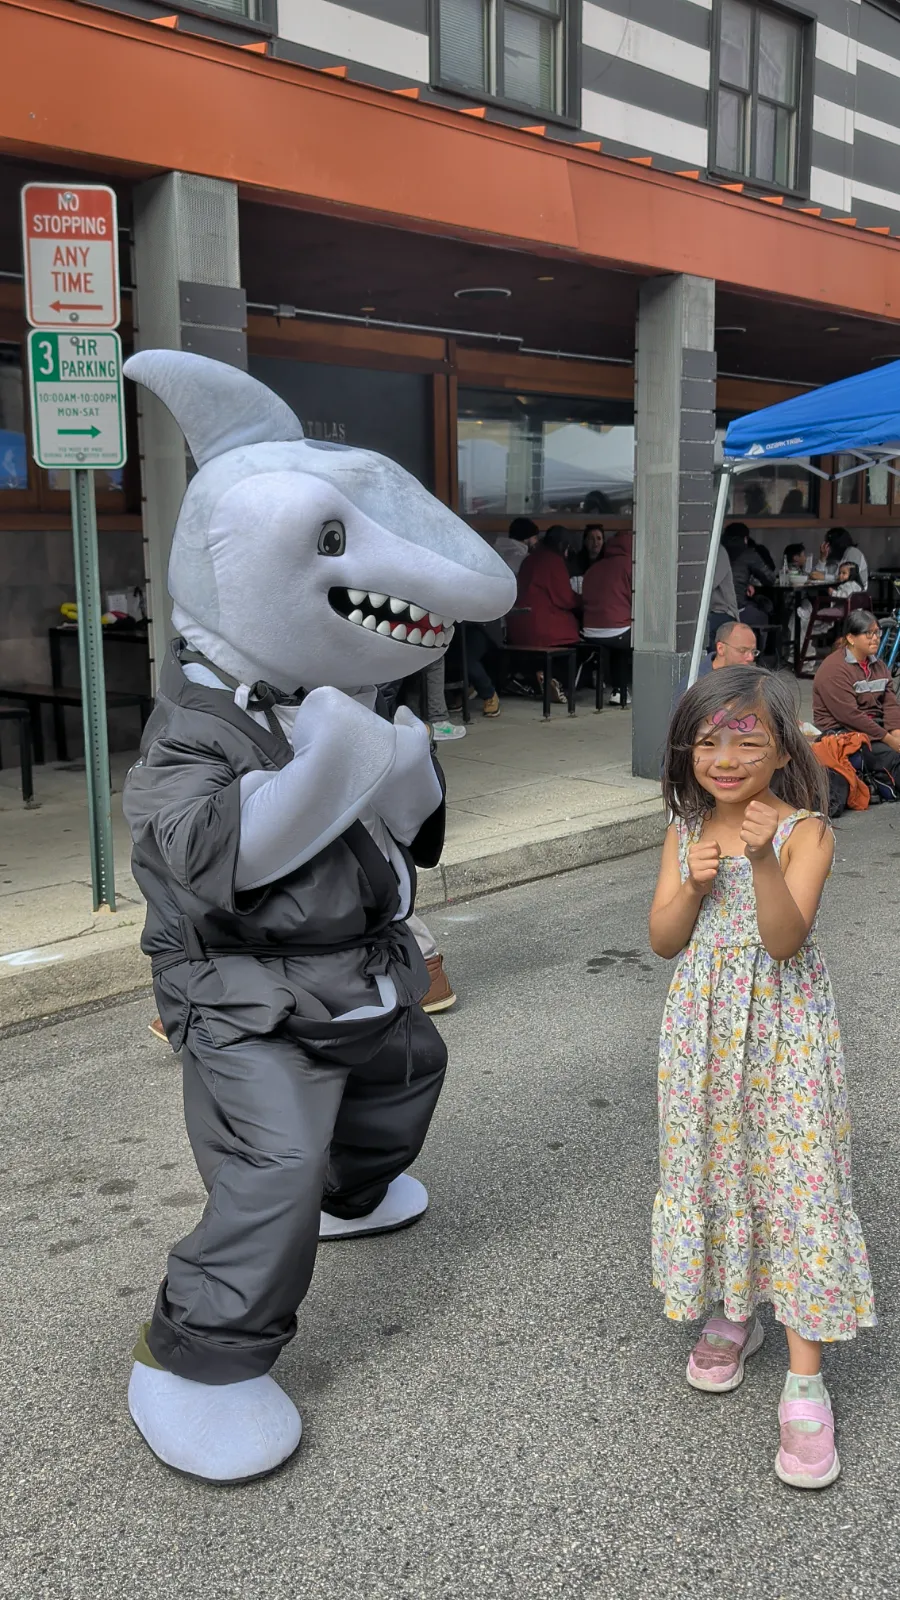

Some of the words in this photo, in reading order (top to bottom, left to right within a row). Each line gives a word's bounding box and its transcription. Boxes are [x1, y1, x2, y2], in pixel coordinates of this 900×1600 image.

[58, 193, 80, 212] NO
[33, 214, 107, 236] STOPPING
[53, 245, 90, 268] ANY
[51, 271, 95, 294] TIME
[75, 339, 98, 356] HR
[38, 340, 54, 375] 3
[61, 360, 116, 378] PARKING
[39, 393, 117, 403] 10:00AM-10:00PM
[57, 407, 100, 417] MON-SAT
